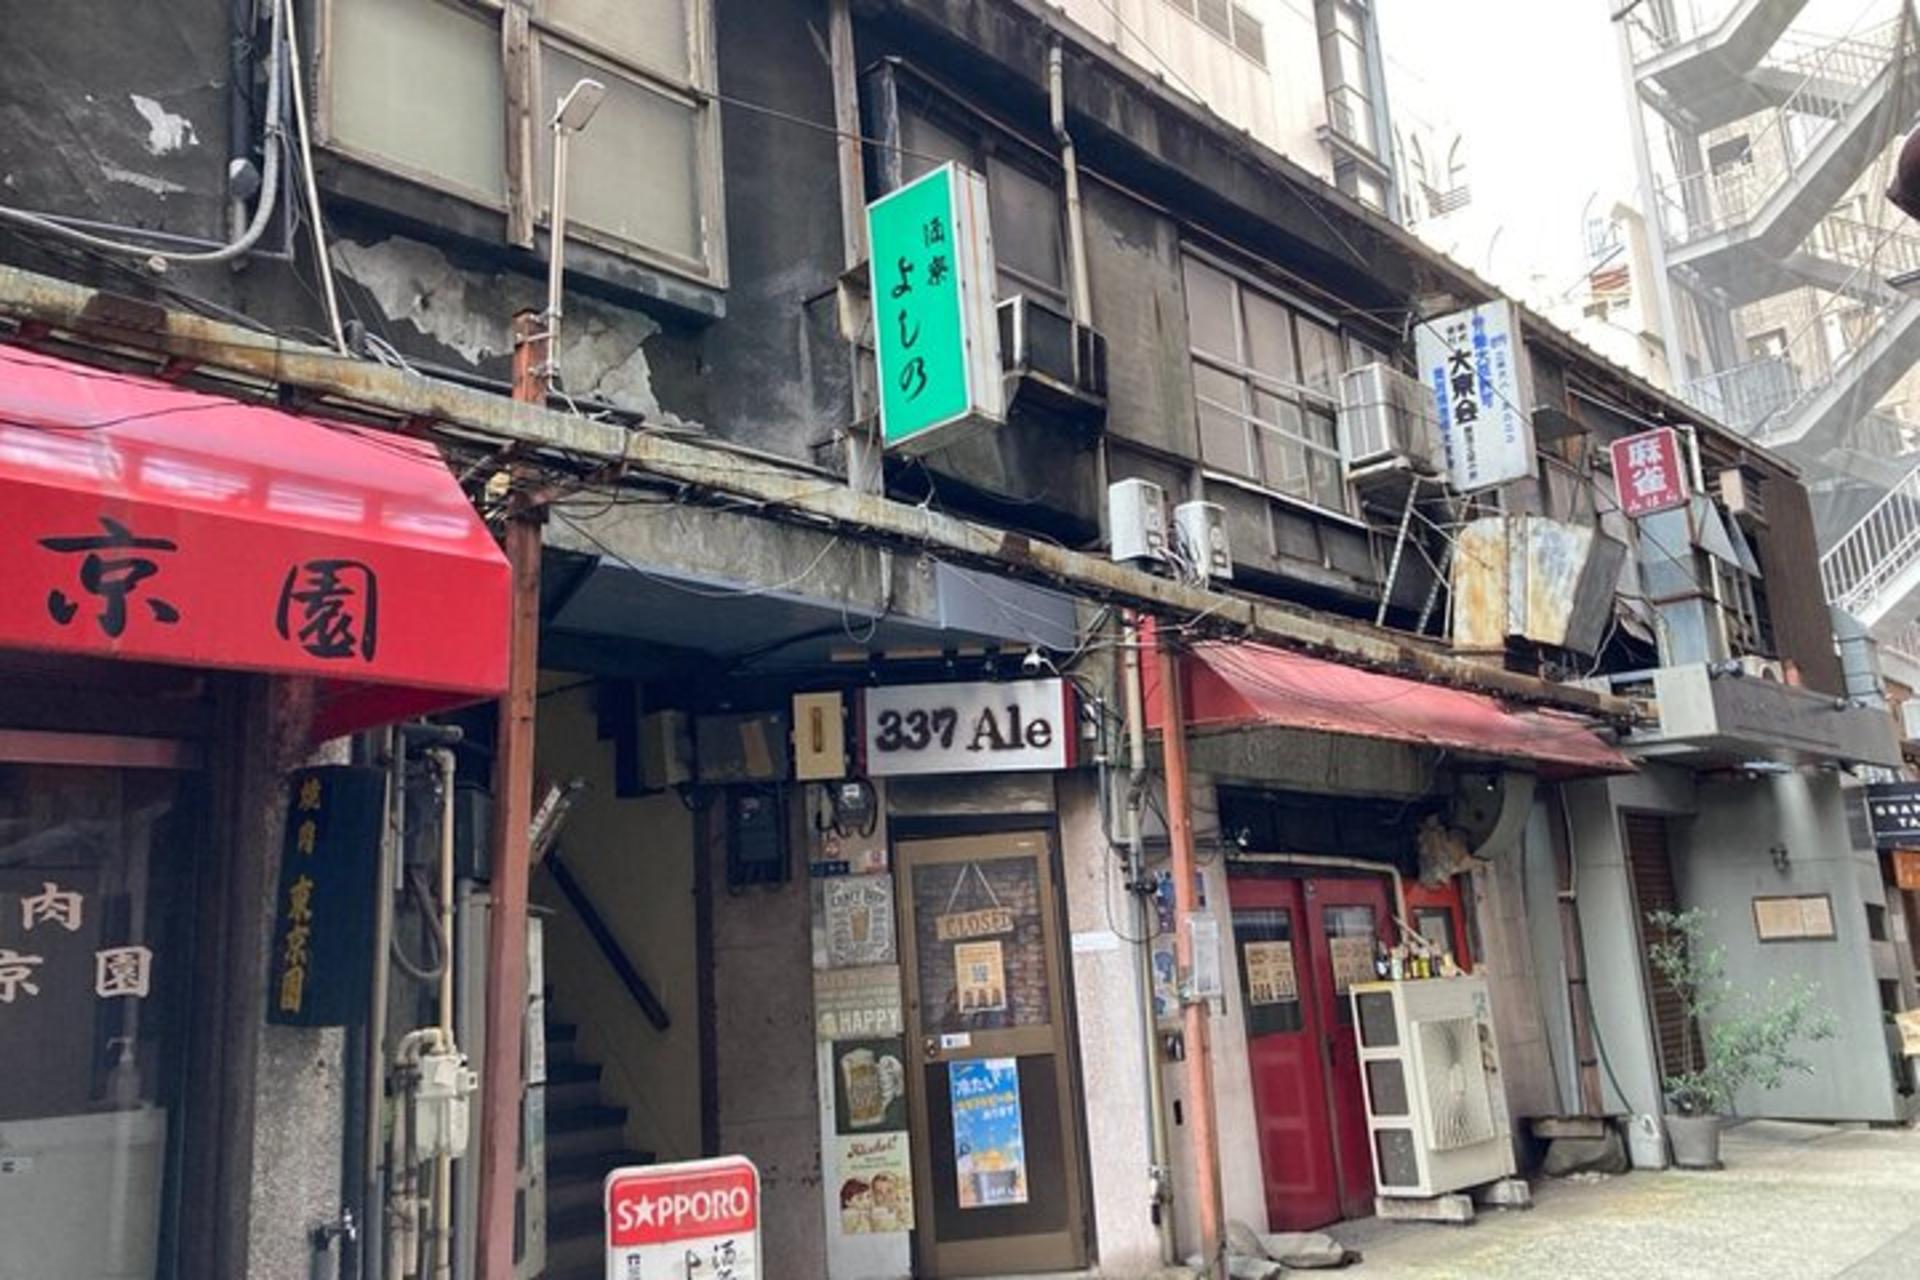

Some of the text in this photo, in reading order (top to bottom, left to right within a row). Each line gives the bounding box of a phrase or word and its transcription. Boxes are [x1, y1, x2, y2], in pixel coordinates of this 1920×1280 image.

[891, 256, 927, 402] よしの
[875, 704, 1052, 751] 337 Ale
[21, 882, 83, 931] 肉
[839, 1009, 898, 1033] HAPPY
